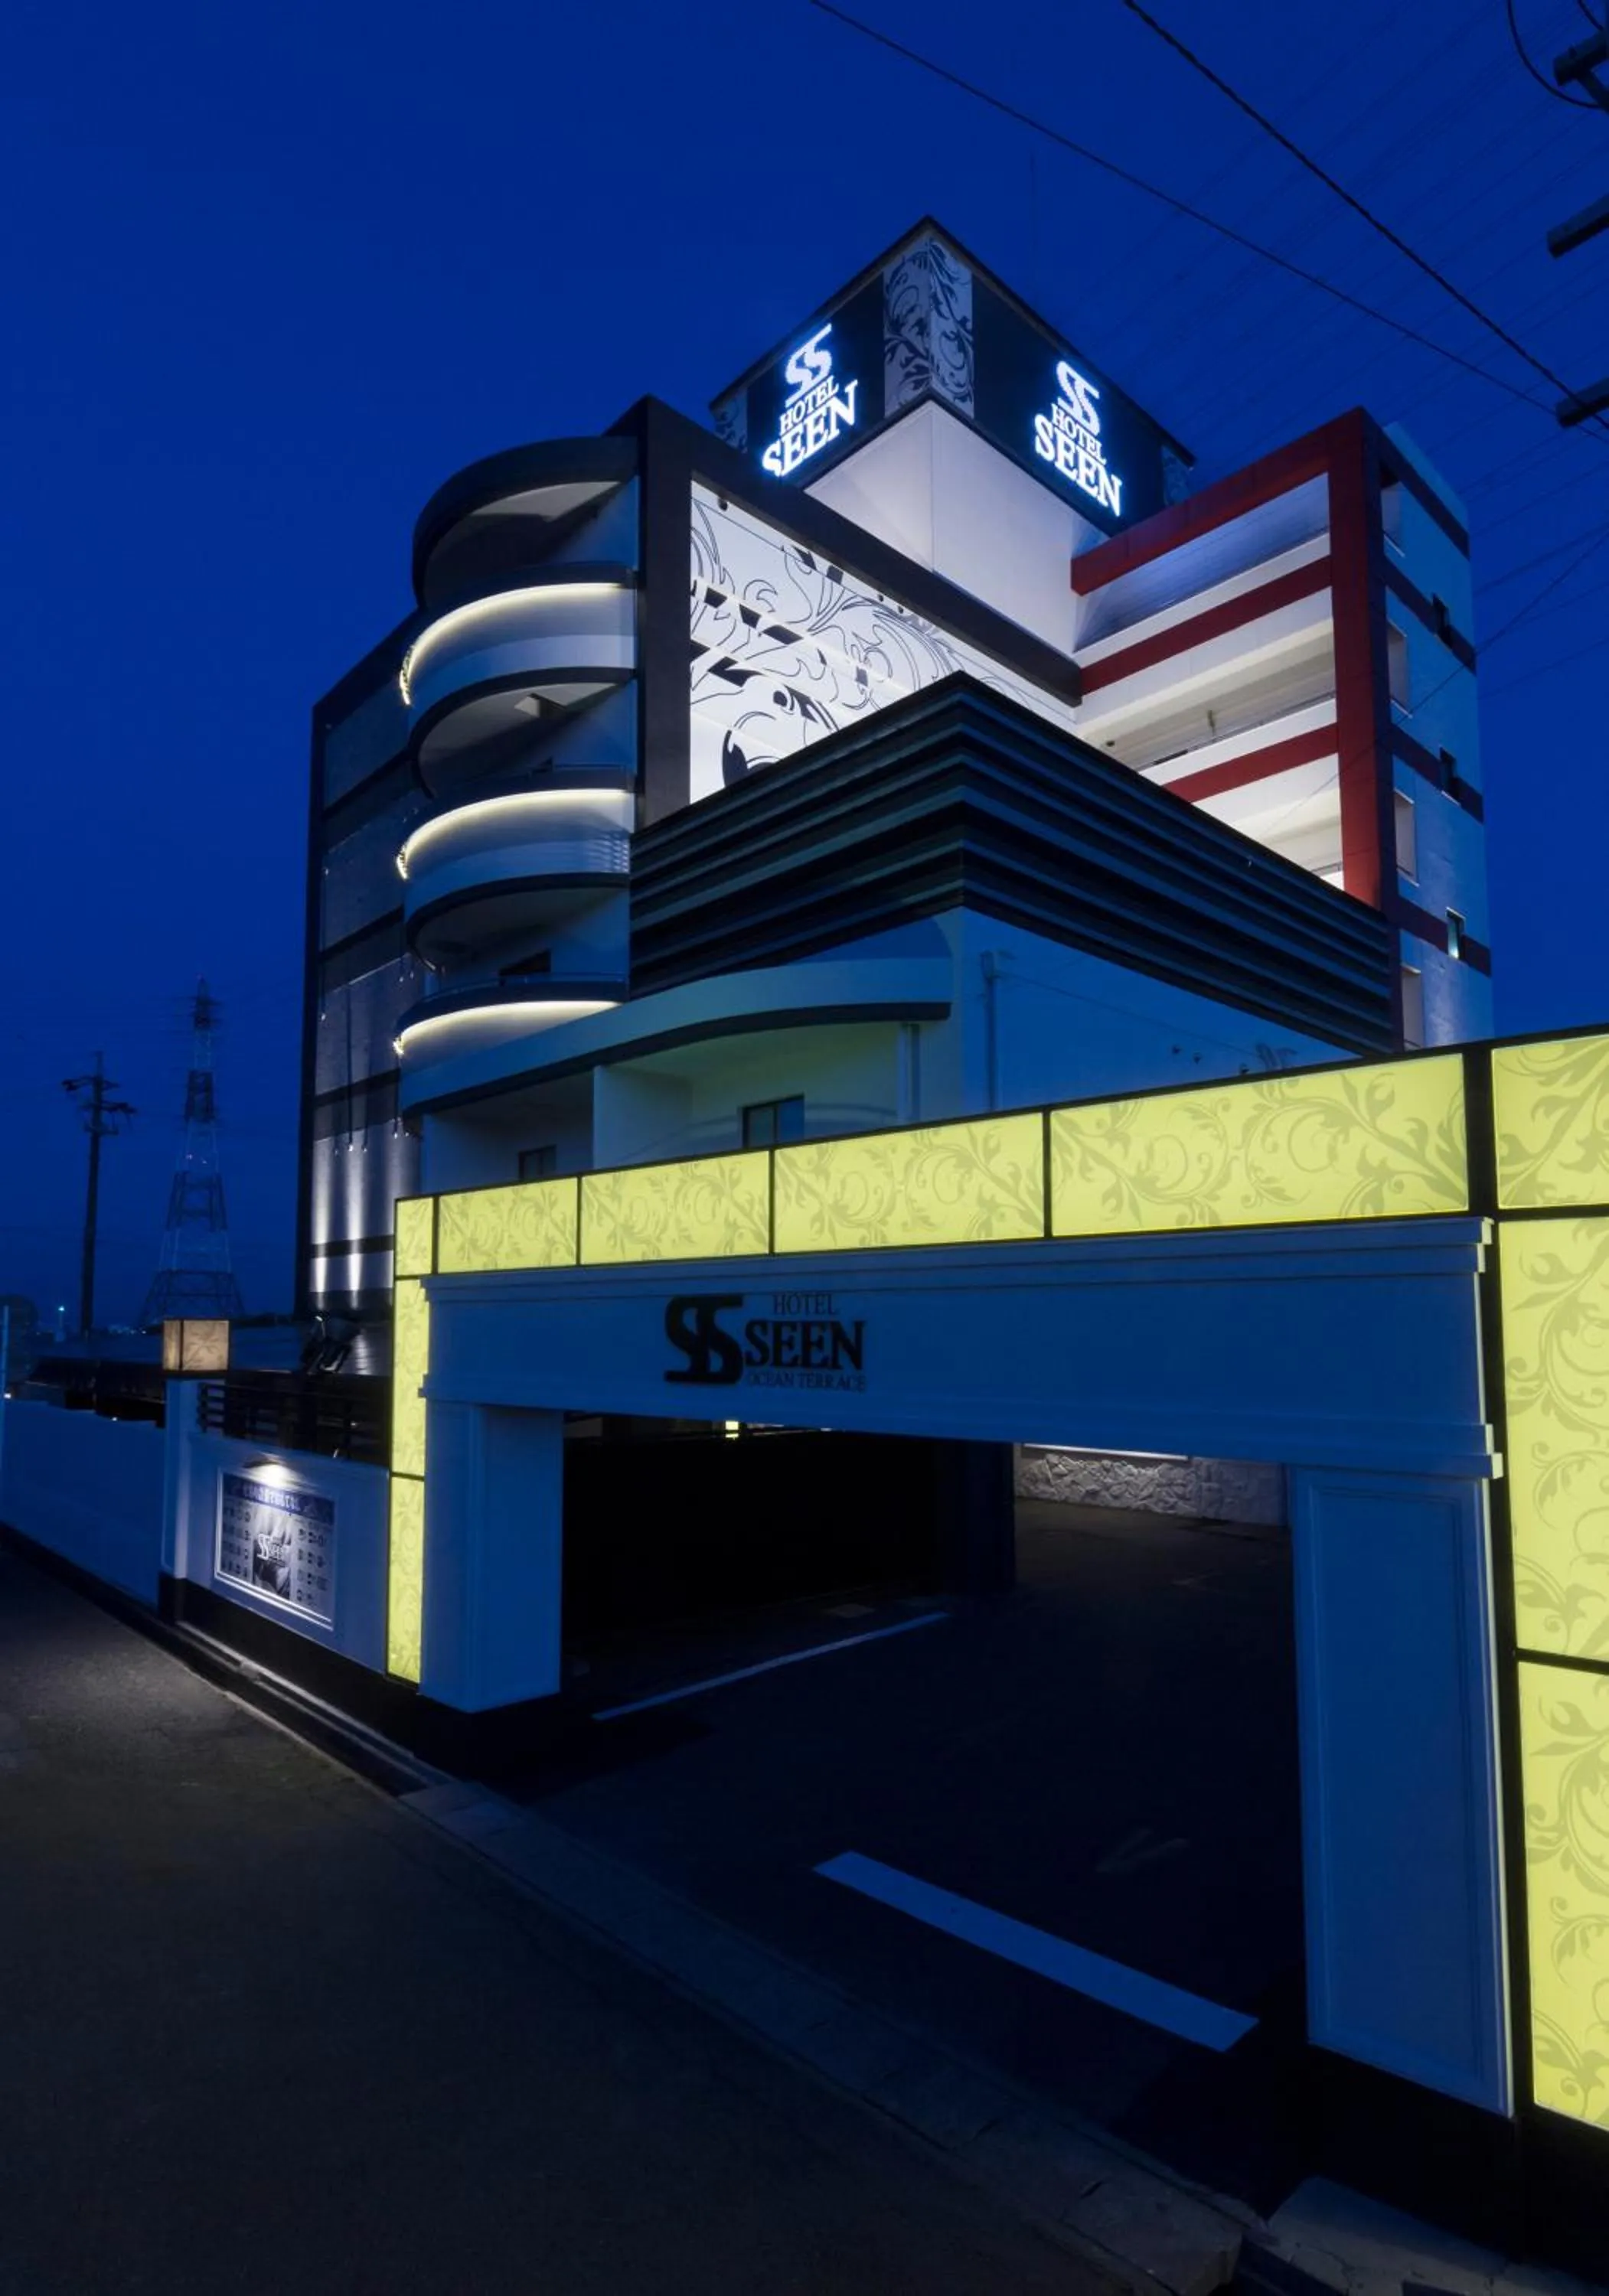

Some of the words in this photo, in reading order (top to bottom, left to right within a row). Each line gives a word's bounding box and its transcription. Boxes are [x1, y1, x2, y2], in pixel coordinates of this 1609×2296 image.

[762, 379, 858, 477] SEEN
[779, 375, 839, 436] HOTEL
[1051, 403, 1107, 465] HOTEL
[1034, 413, 1122, 517] SEEN
[772, 1291, 840, 1315] HOTEL
[745, 1319, 867, 1371] SEEN
[749, 1371, 795, 1388] OCEAN
[798, 1371, 867, 1394] TERRACE
